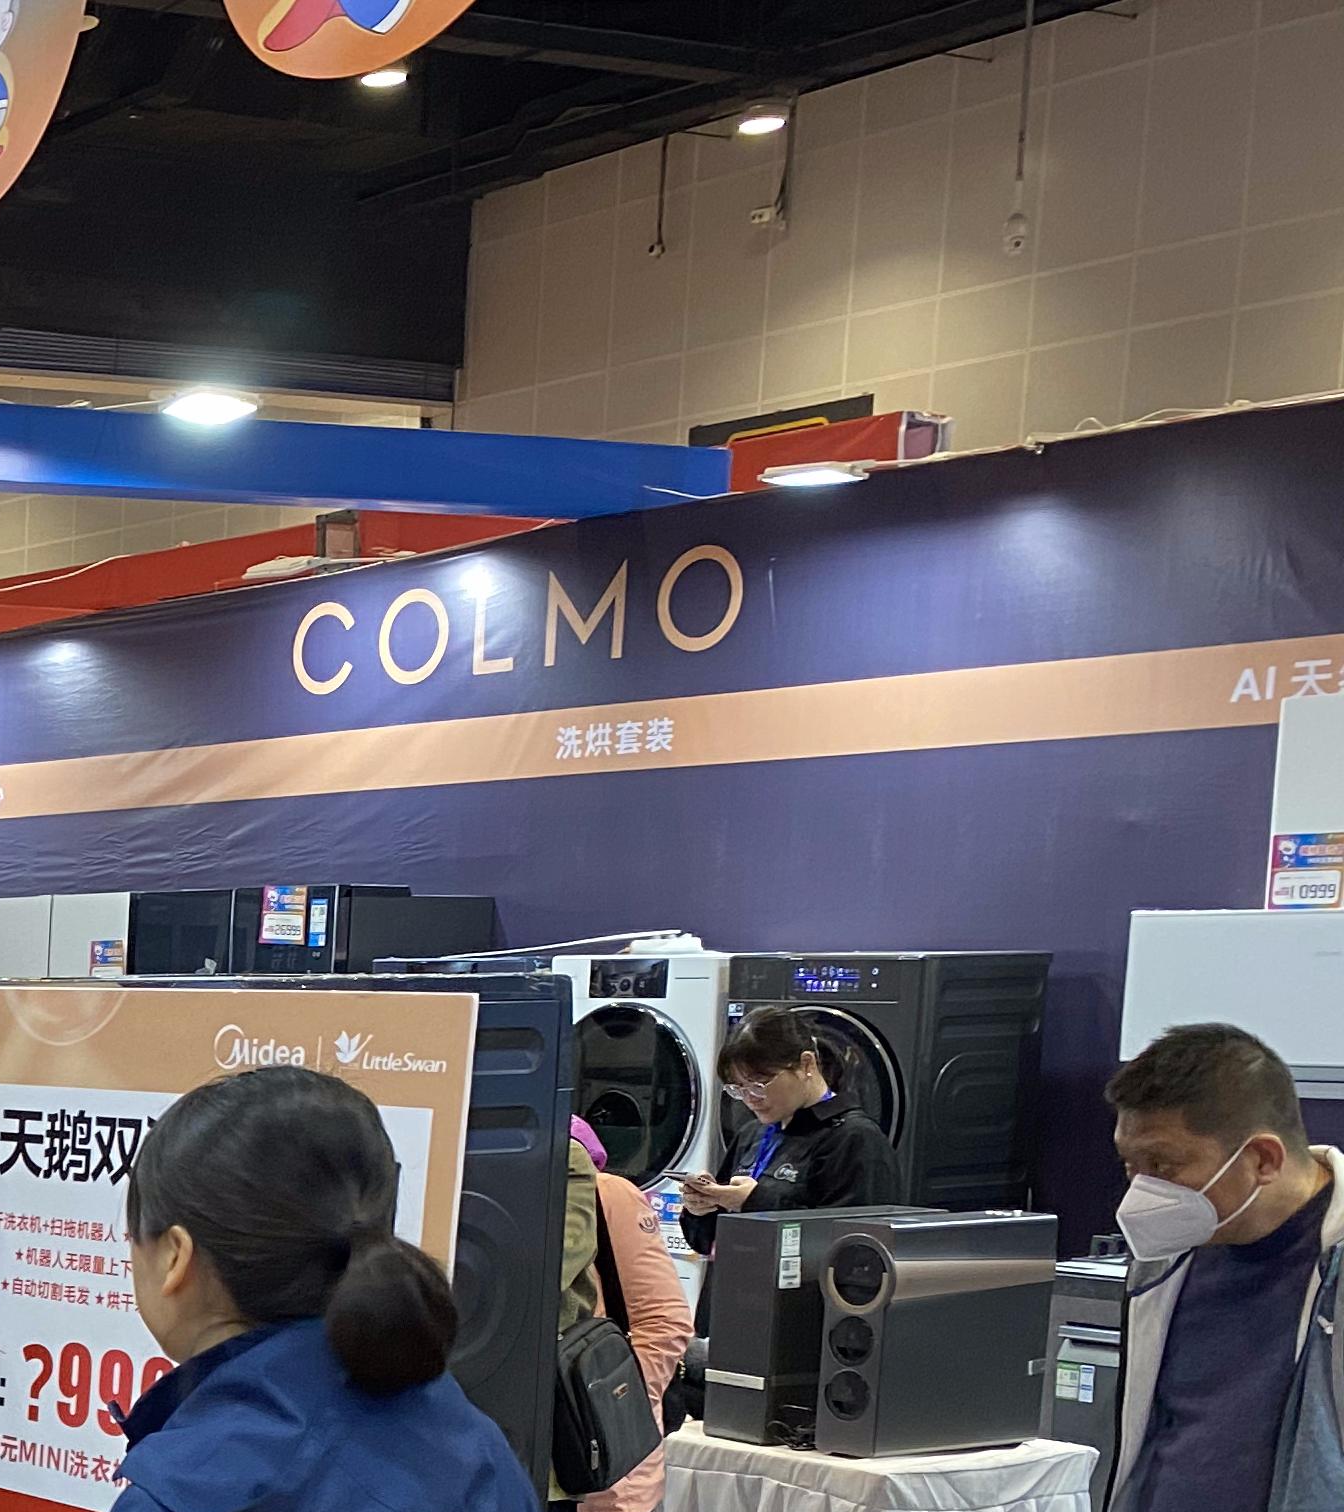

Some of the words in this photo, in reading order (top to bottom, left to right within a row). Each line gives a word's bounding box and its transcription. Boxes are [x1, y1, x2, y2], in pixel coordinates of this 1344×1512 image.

[292, 544, 744, 696] COLMO
[1230, 665, 1275, 704] AI
[554, 717, 675, 761] 洗烘套装
[214, 1024, 306, 1070] Midea
[362, 1052, 448, 1073] LittleSwan
[106, 1290, 141, 1313] 烘干
